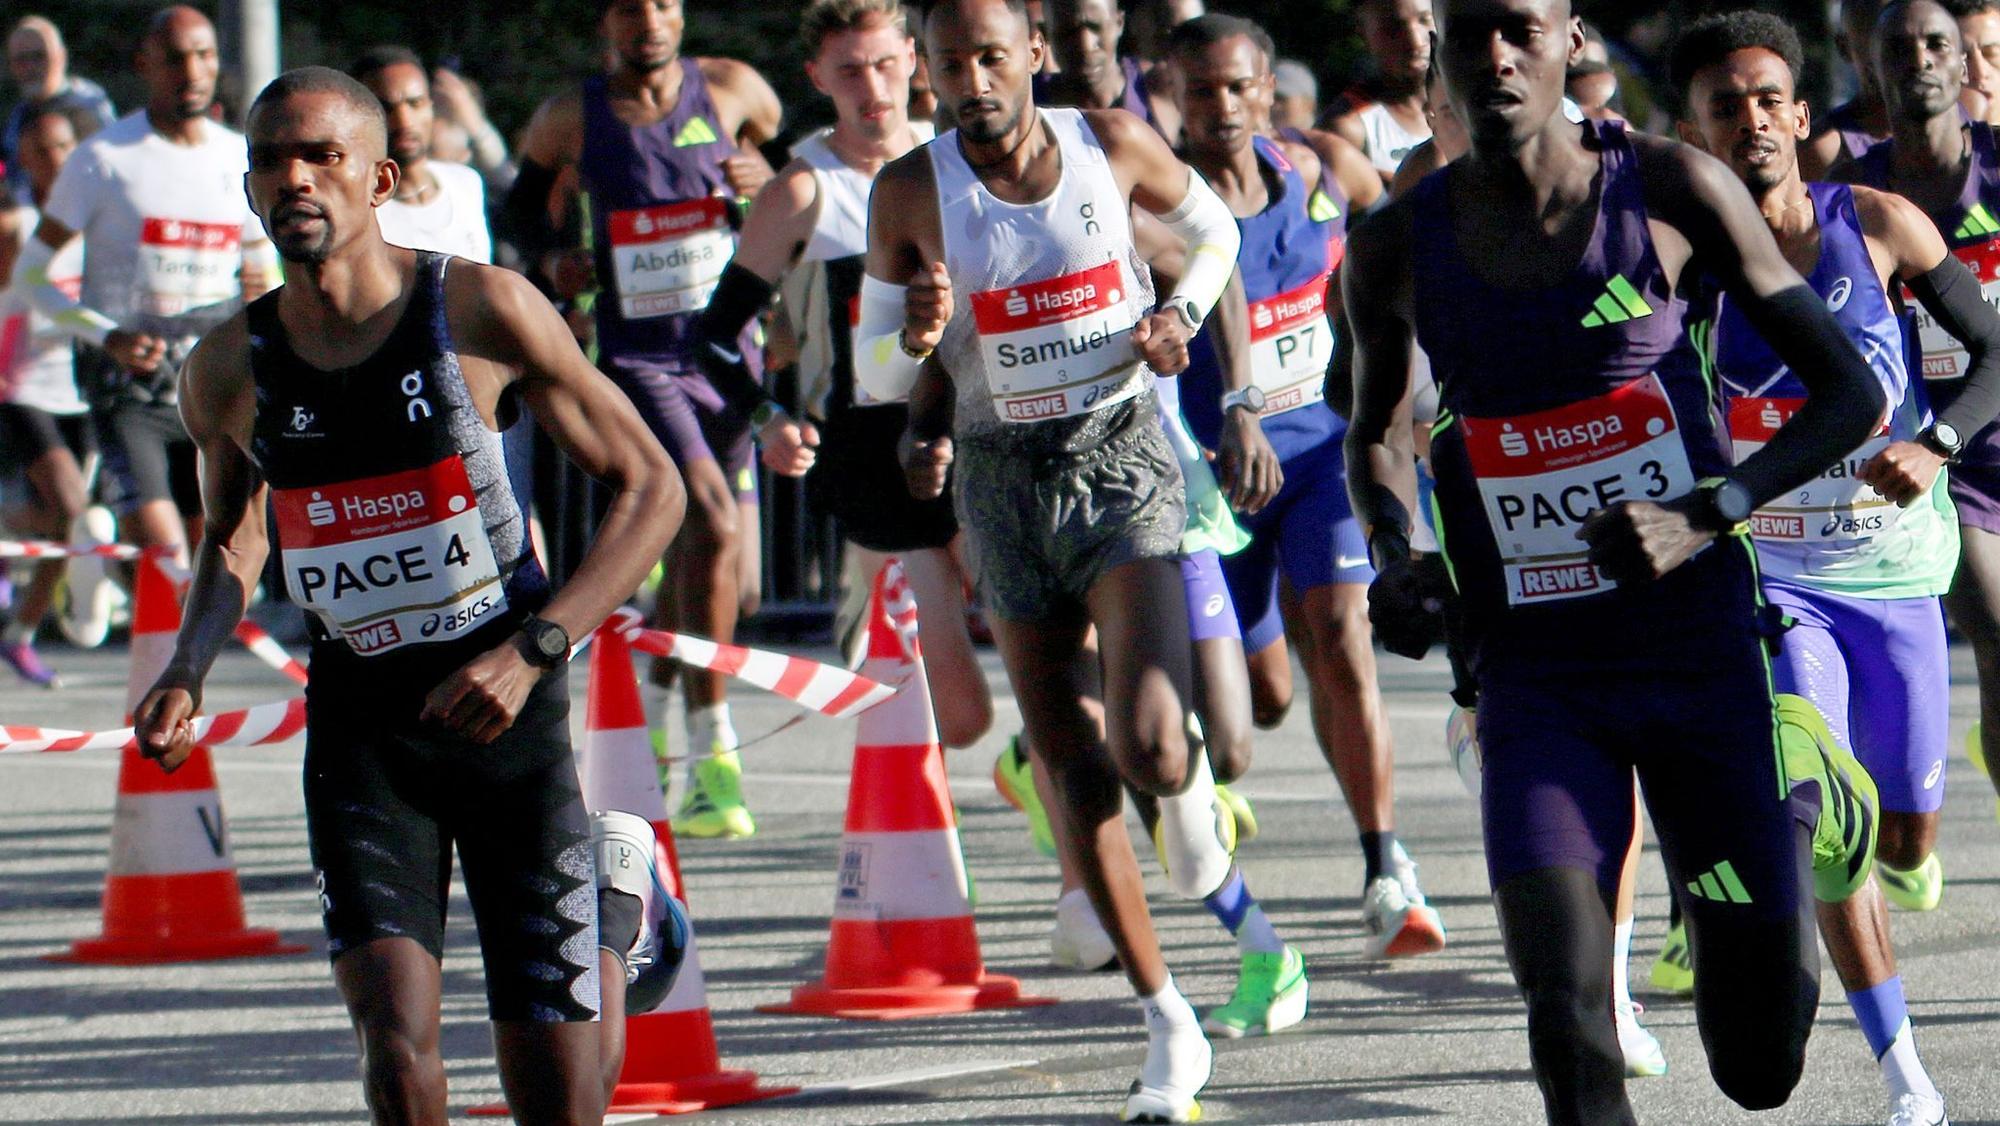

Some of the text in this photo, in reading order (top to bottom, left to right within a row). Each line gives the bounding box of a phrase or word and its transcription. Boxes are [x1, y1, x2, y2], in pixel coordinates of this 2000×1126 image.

[631, 245, 714, 273] Abdisa
[1035, 283, 1096, 311] Haspa
[1276, 291, 1322, 321] Haspa
[998, 320, 1111, 369] Samuel
[1275, 325, 1317, 370] P7
[1058, 369, 1069, 383] 3
[1923, 357, 1955, 375] EWE
[1008, 396, 1065, 418] REWE
[1534, 414, 1623, 452] Haspa
[1639, 460, 1669, 498] 3
[341, 490, 425, 521] Haspa
[1800, 491, 1810, 505] 2
[1752, 515, 1883, 536] REWE asics
[298, 533, 470, 603] PACE 4
[1523, 567, 1596, 593] REWE
[444, 596, 492, 632] asics
